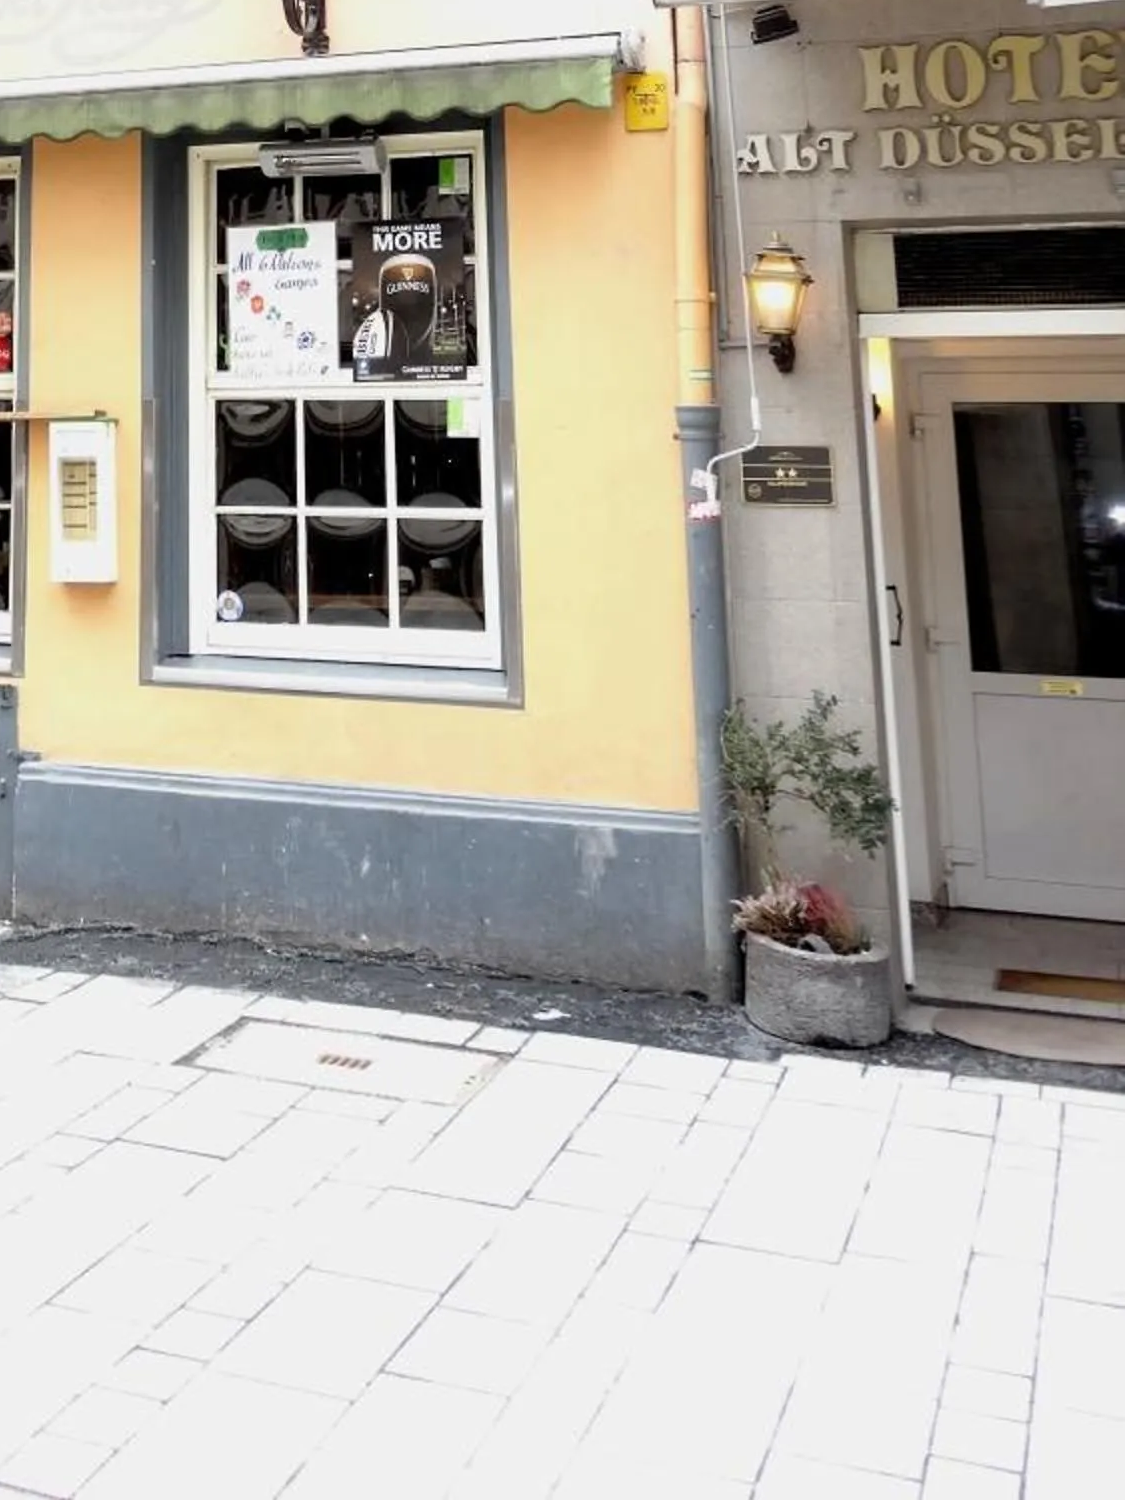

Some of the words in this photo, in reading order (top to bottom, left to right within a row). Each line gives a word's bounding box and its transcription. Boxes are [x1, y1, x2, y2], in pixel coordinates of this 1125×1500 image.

[858, 29, 1125, 112] HOTE
[736, 128, 857, 174] ALT
[372, 231, 443, 252] MORE
[386, 281, 430, 295] GUINNESS
